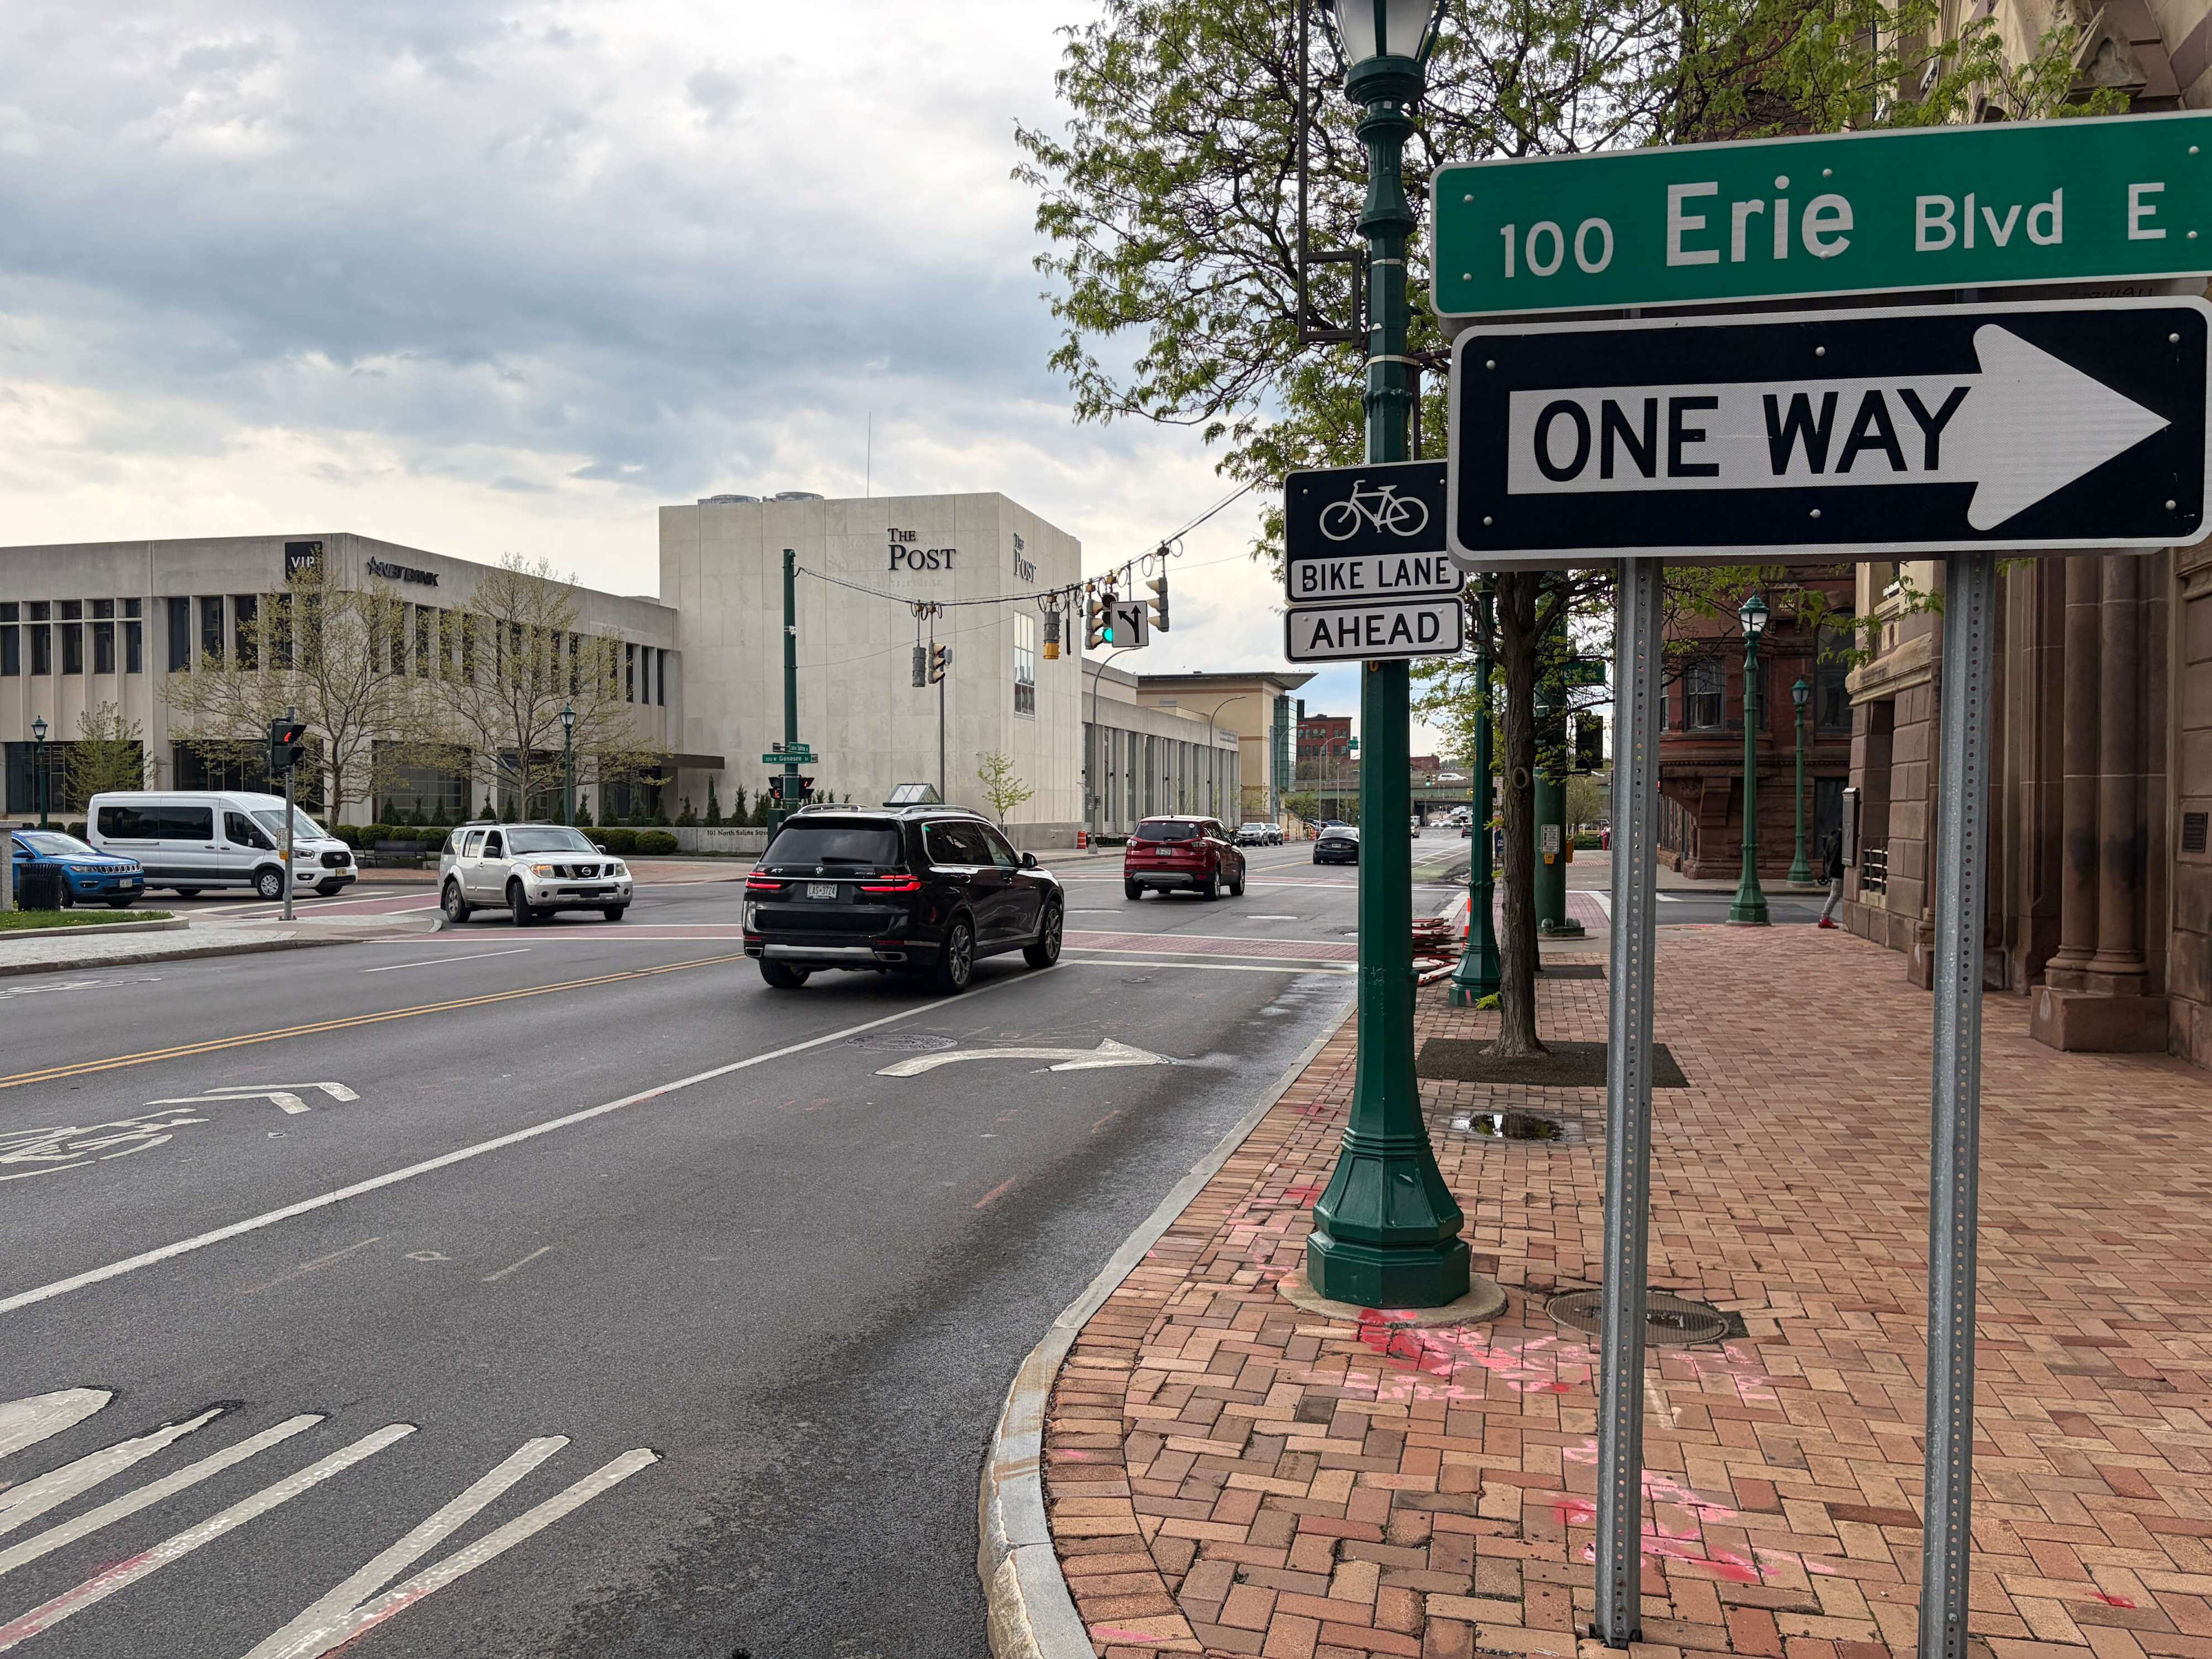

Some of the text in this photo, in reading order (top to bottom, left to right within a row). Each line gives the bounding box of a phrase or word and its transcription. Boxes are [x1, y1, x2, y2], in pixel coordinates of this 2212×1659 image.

[1500, 175, 2167, 278] 100 Erie Blvd E
[1534, 386, 1972, 482] ONE WAY
[888, 528, 916, 542] THE
[1014, 532, 1025, 549] THE
[291, 556, 315, 568] VIP
[888, 544, 956, 570] POST
[1013, 548, 1037, 583] POST
[403, 567, 440, 587] BANK
[1302, 556, 1451, 592] BIKE LANE
[1309, 611, 1439, 649] AHEAD
